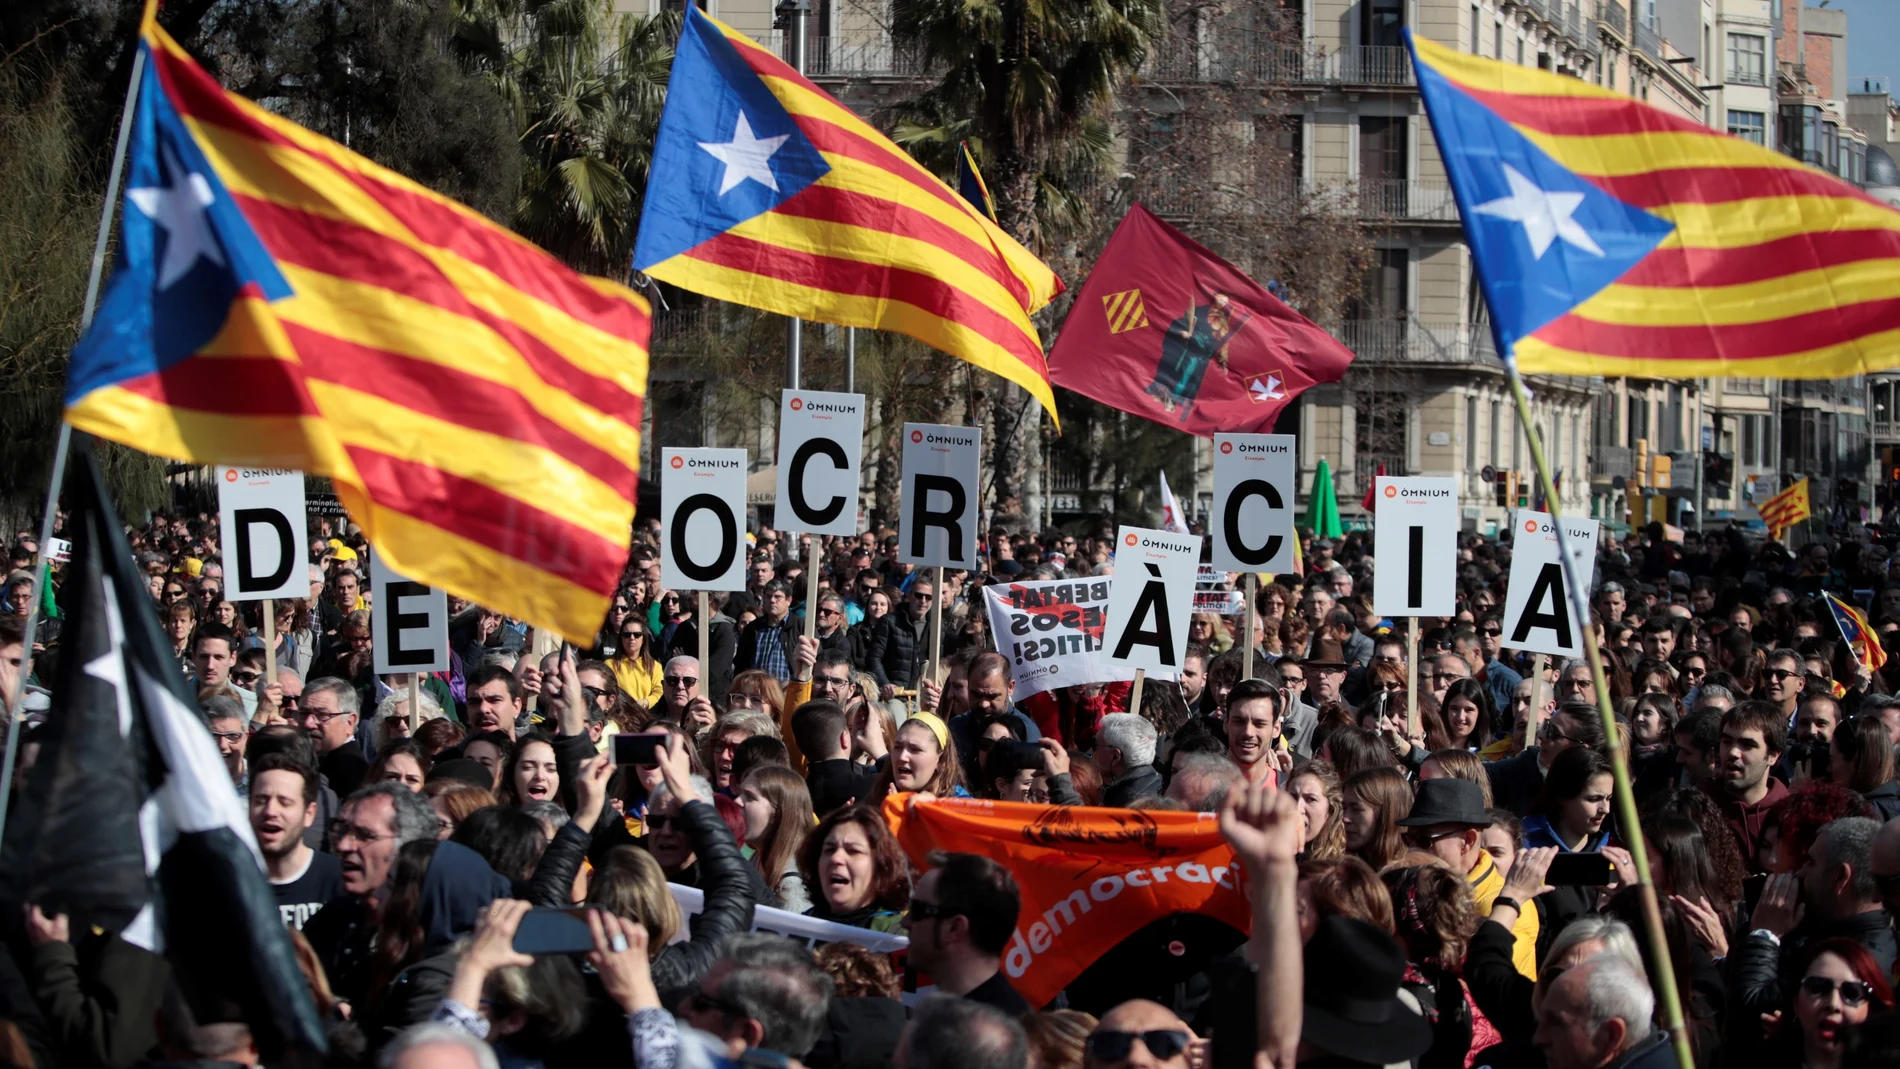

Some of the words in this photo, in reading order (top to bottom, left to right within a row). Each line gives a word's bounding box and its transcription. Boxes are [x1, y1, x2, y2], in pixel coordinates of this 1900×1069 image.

[806, 401, 856, 414] ÒMNIUM
[926, 433, 973, 447] ÒMNIUM
[1239, 443, 1288, 453] ÒMNIUM
[304, 499, 343, 508] ermination
[688, 458, 739, 468] ÒMNIUM
[788, 437, 849, 526] C
[1401, 488, 1450, 497] ÒMNIUM
[234, 508, 296, 593] D
[671, 493, 738, 582] O
[911, 473, 965, 562] R
[1142, 537, 1192, 554] ÒMNIUM
[1224, 479, 1284, 566] C
[1408, 526, 1423, 608] I
[1510, 562, 1573, 649] A
[385, 581, 435, 666] E
[1112, 562, 1176, 667] À
[1005, 861, 1241, 979] democraci
